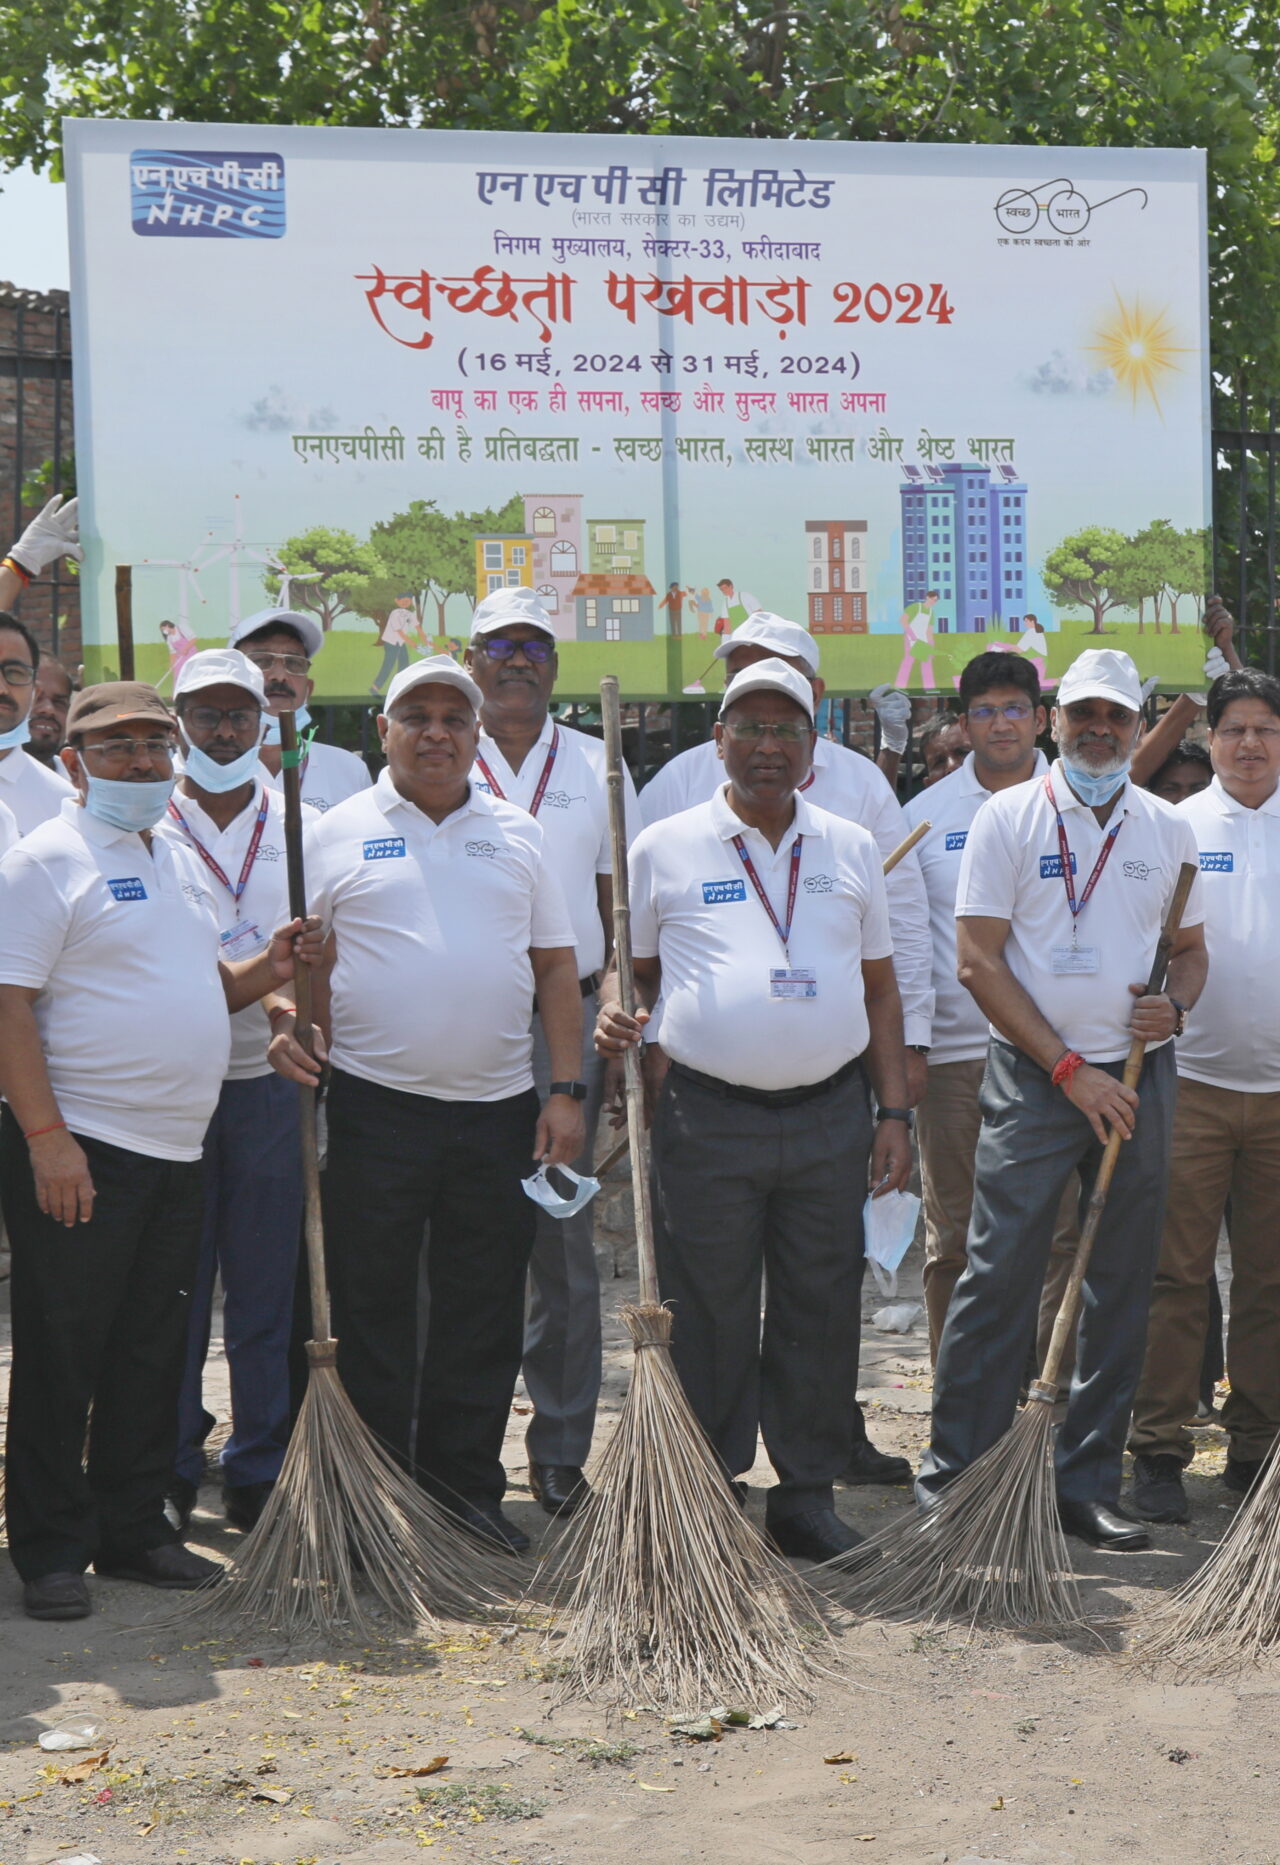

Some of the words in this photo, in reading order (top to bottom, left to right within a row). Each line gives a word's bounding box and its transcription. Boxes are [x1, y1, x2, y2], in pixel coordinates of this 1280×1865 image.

[703, 168, 835, 209] लिमिटेड
[147, 198, 265, 226] NHPC
[572, 209, 611, 228] (भारत
[620, 212, 668, 227] सरकार
[678, 213, 696, 228] का
[704, 212, 745, 231] उद्यम)
[1005, 207, 1031, 217] स्वच्छ
[1056, 208, 1080, 218] भारत
[494, 230, 541, 255] निगम
[552, 238, 631, 264] मुख्यालय,
[643, 232, 732, 263] सेक्टर-33,
[742, 235, 821, 260] फरीदाबाद
[353, 263, 578, 350] स्वच्छता
[603, 269, 812, 341] पखवाड़ा
[832, 282, 955, 324] 2024
[516, 348, 562, 377] मई,
[573, 354, 642, 373] 2024
[651, 348, 673, 374] से
[682, 355, 713, 373] 31
[724, 350, 768, 379] मई,
[780, 352, 861, 380] 2024)
[431, 389, 467, 419] बापू
[474, 390, 497, 411] का
[508, 390, 538, 414] एक
[549, 382, 567, 412] ही
[577, 391, 630, 416] सपना,
[640, 391, 682, 413] स्वच्छ
[693, 382, 725, 414] और
[735, 392, 776, 422] सुन्दर
[787, 392, 828, 413] भारत
[840, 392, 887, 413] अपना
[292, 426, 405, 464] एनएचपीसी
[418, 426, 444, 461] की
[456, 425, 472, 463] है
[484, 427, 579, 463] प्रतिबद्धता
[613, 437, 663, 463] स्वच्छ
[674, 437, 732, 468] भारत,
[744, 437, 793, 462] स्वस्थ
[806, 437, 854, 462] भारत
[867, 427, 904, 464] और
[916, 428, 955, 464] श्रेष्ठ
[967, 437, 1015, 464] भारत
[368, 849, 399, 857] NHPC
[708, 893, 740, 901] NHPC
